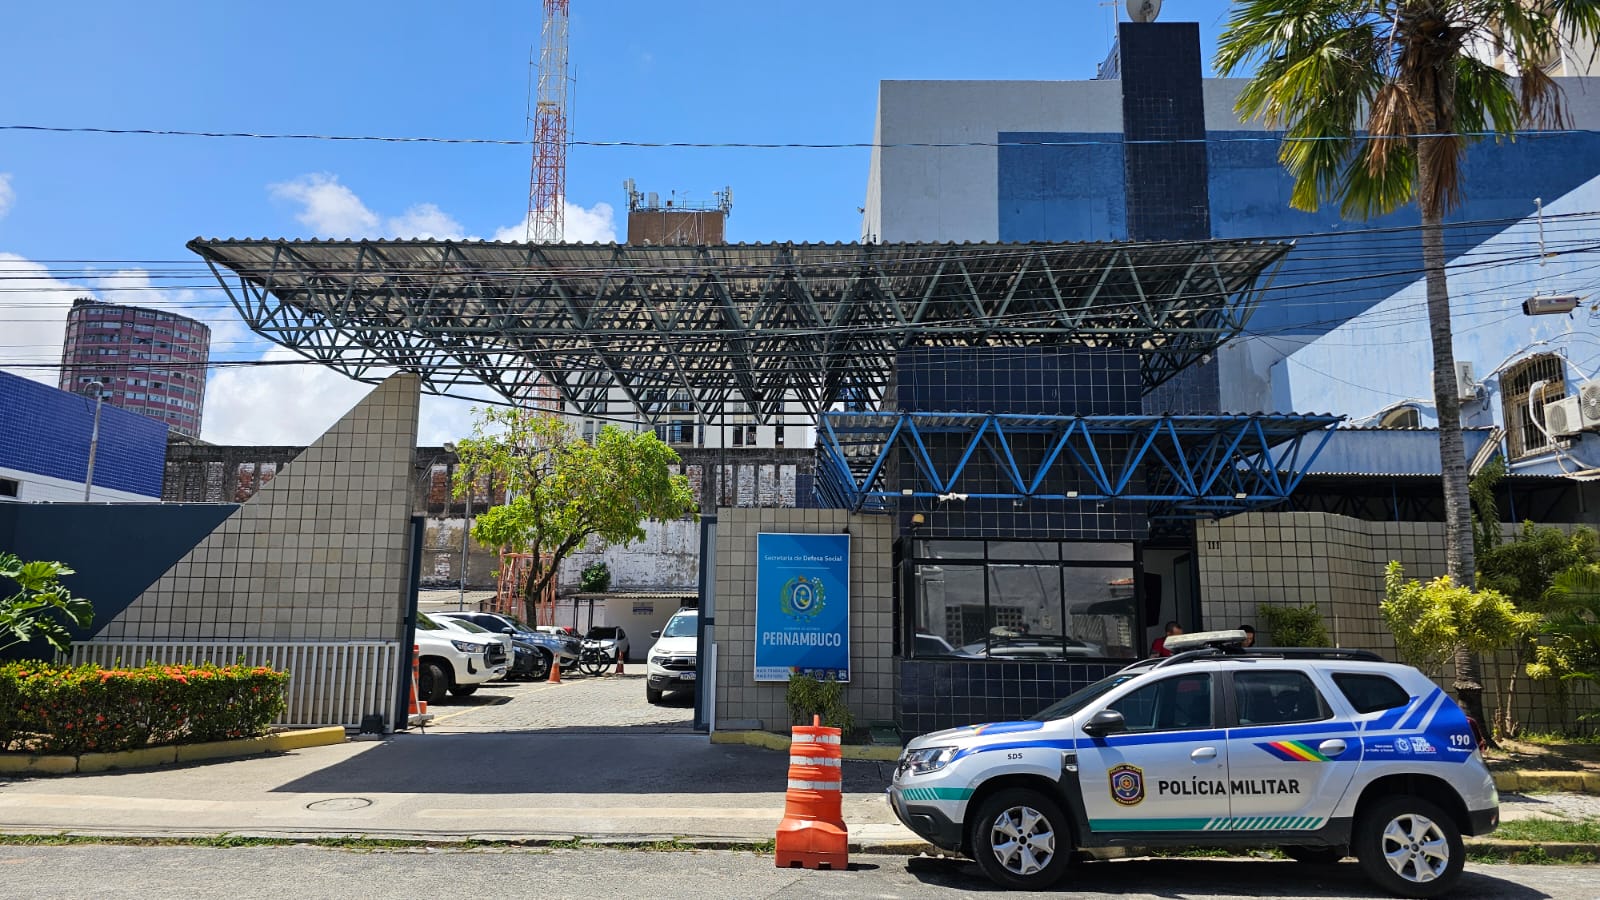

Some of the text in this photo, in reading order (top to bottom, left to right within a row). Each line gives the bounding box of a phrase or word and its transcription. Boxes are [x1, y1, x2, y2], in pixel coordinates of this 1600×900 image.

[763, 632, 841, 646] PERNAMBUCO
[1450, 734, 1470, 746] 190
[1159, 776, 1300, 795] POLÍCIA MILITAR
